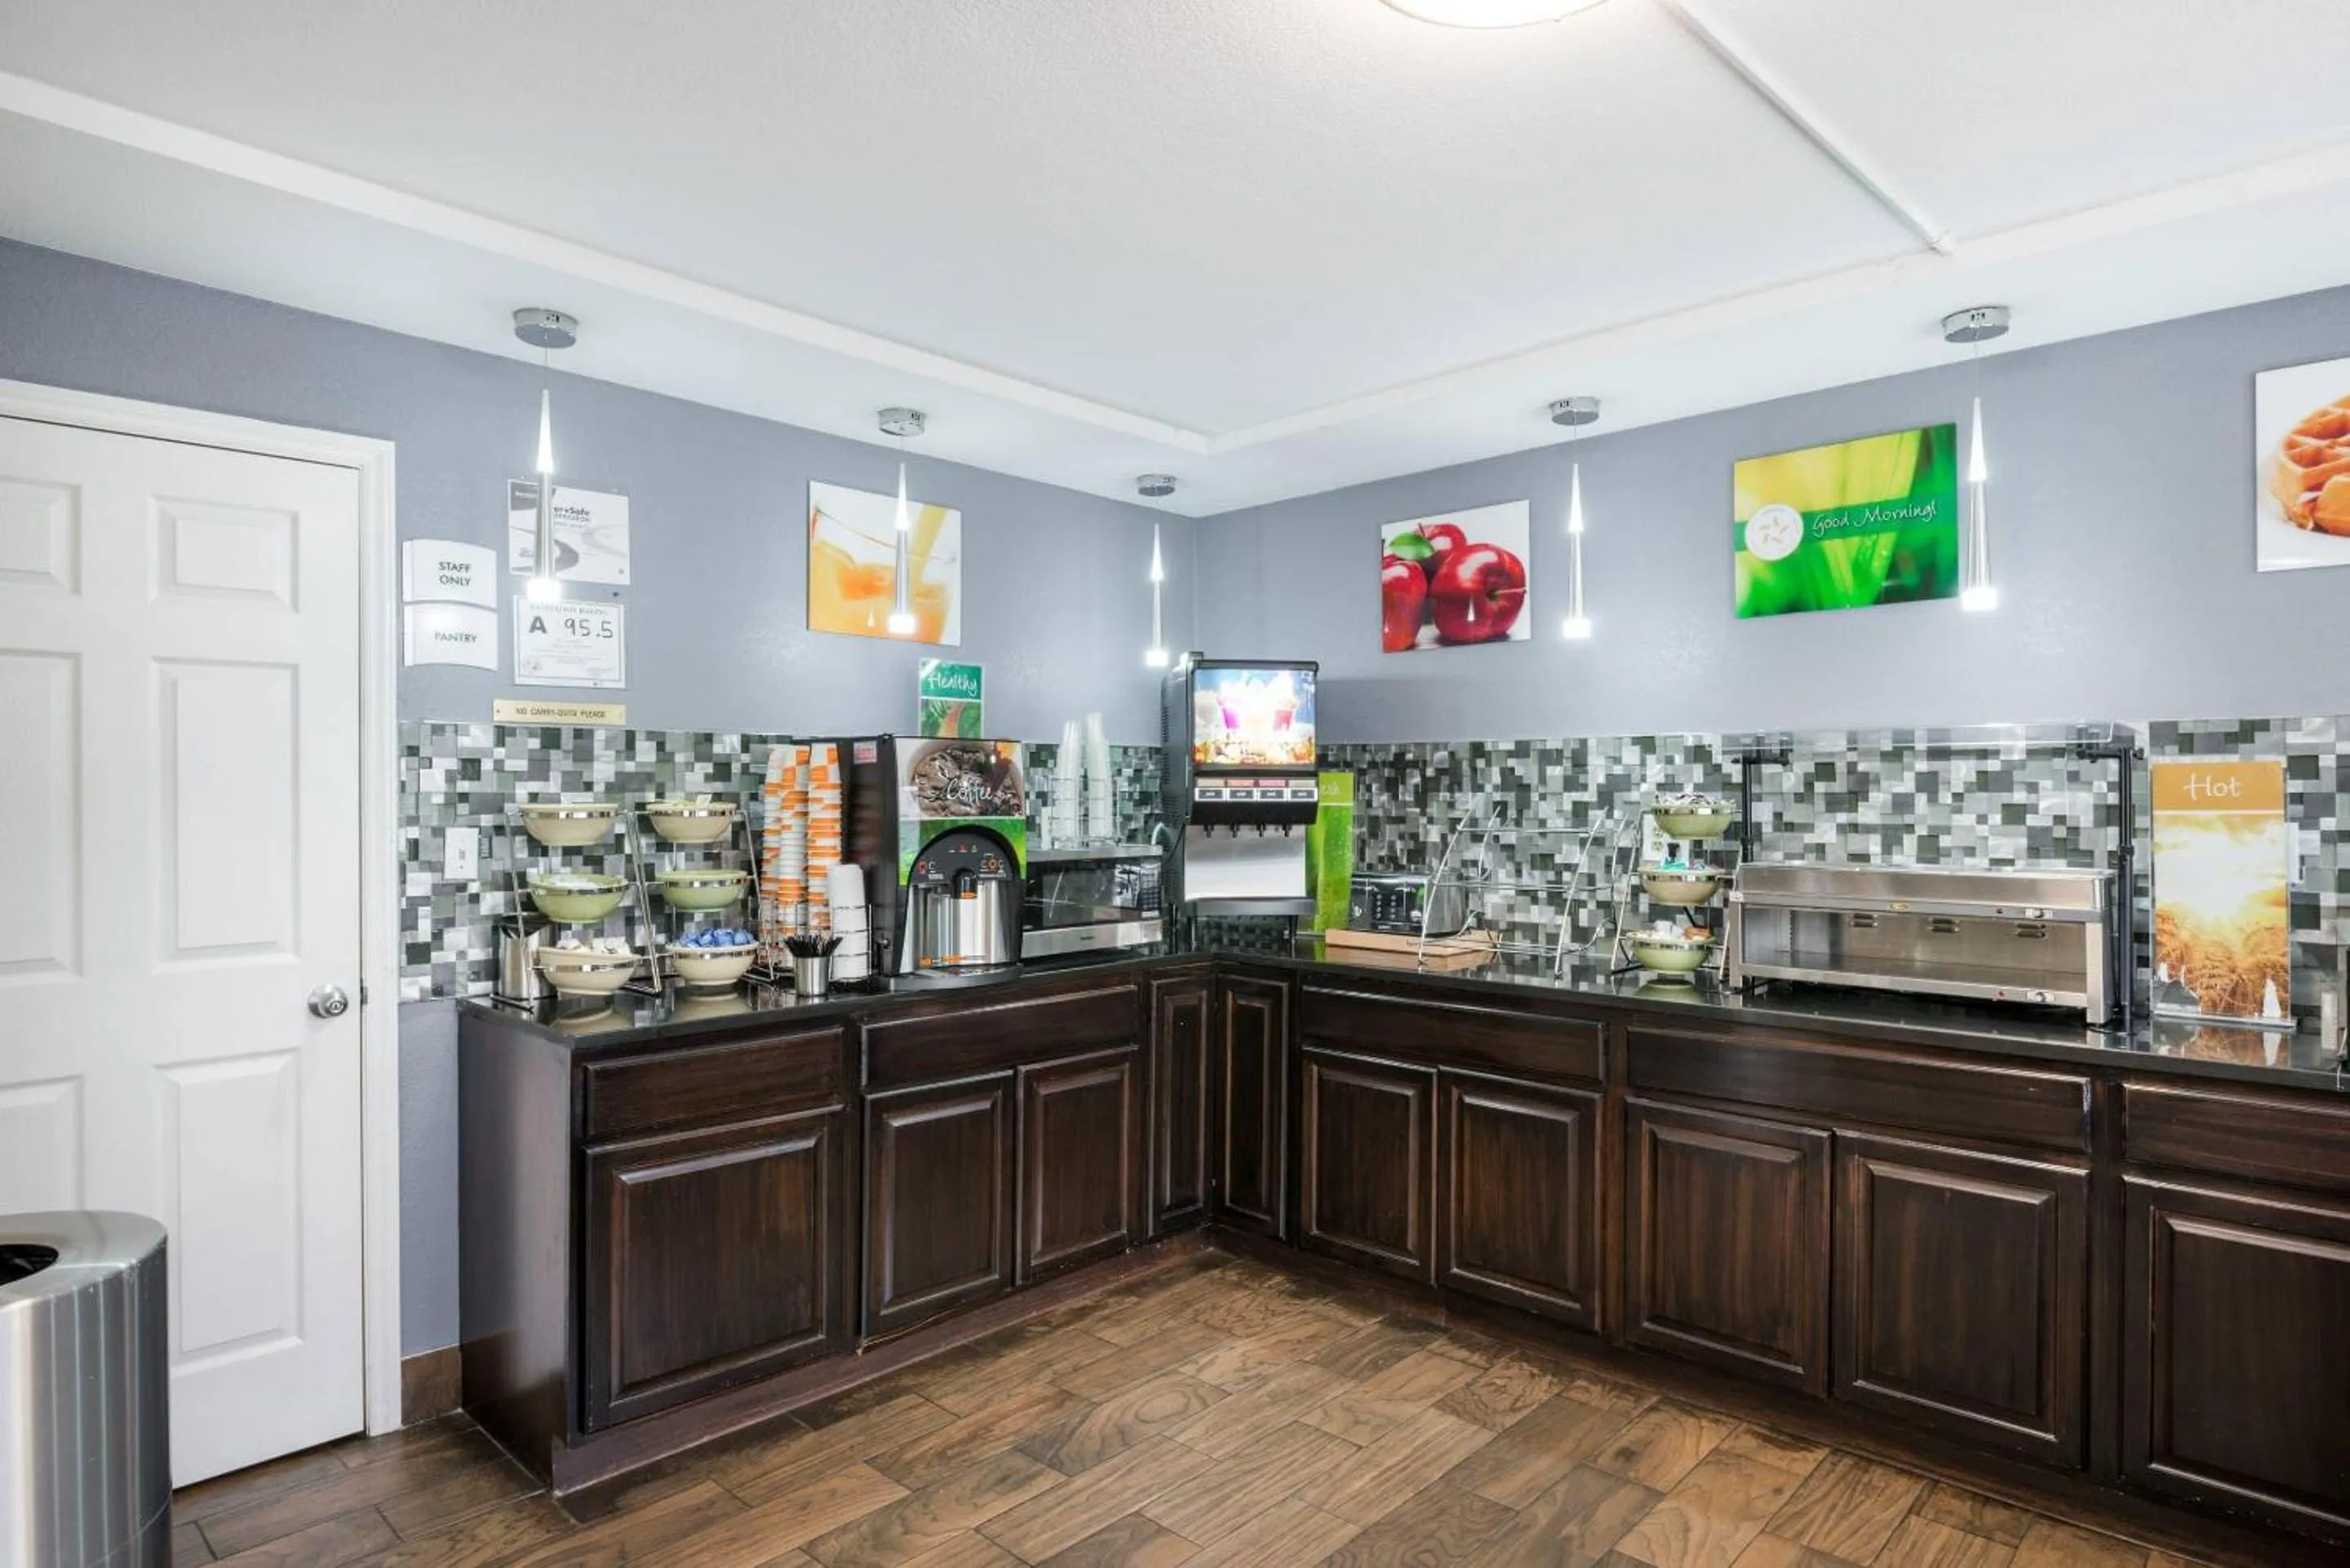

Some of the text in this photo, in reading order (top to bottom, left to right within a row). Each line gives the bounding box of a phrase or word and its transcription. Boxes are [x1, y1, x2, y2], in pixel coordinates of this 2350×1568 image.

[1812, 500, 1936, 538] Good Morning!
[438, 561, 471, 573] STAFF
[439, 574, 471, 587] ONLY
[435, 631, 477, 643] PANTRY
[529, 615, 614, 638] A 95.5
[927, 672, 978, 697] Healthy
[580, 710, 607, 719] PLEASE
[947, 776, 993, 802] Coffee
[2183, 773, 2242, 800] Hot
